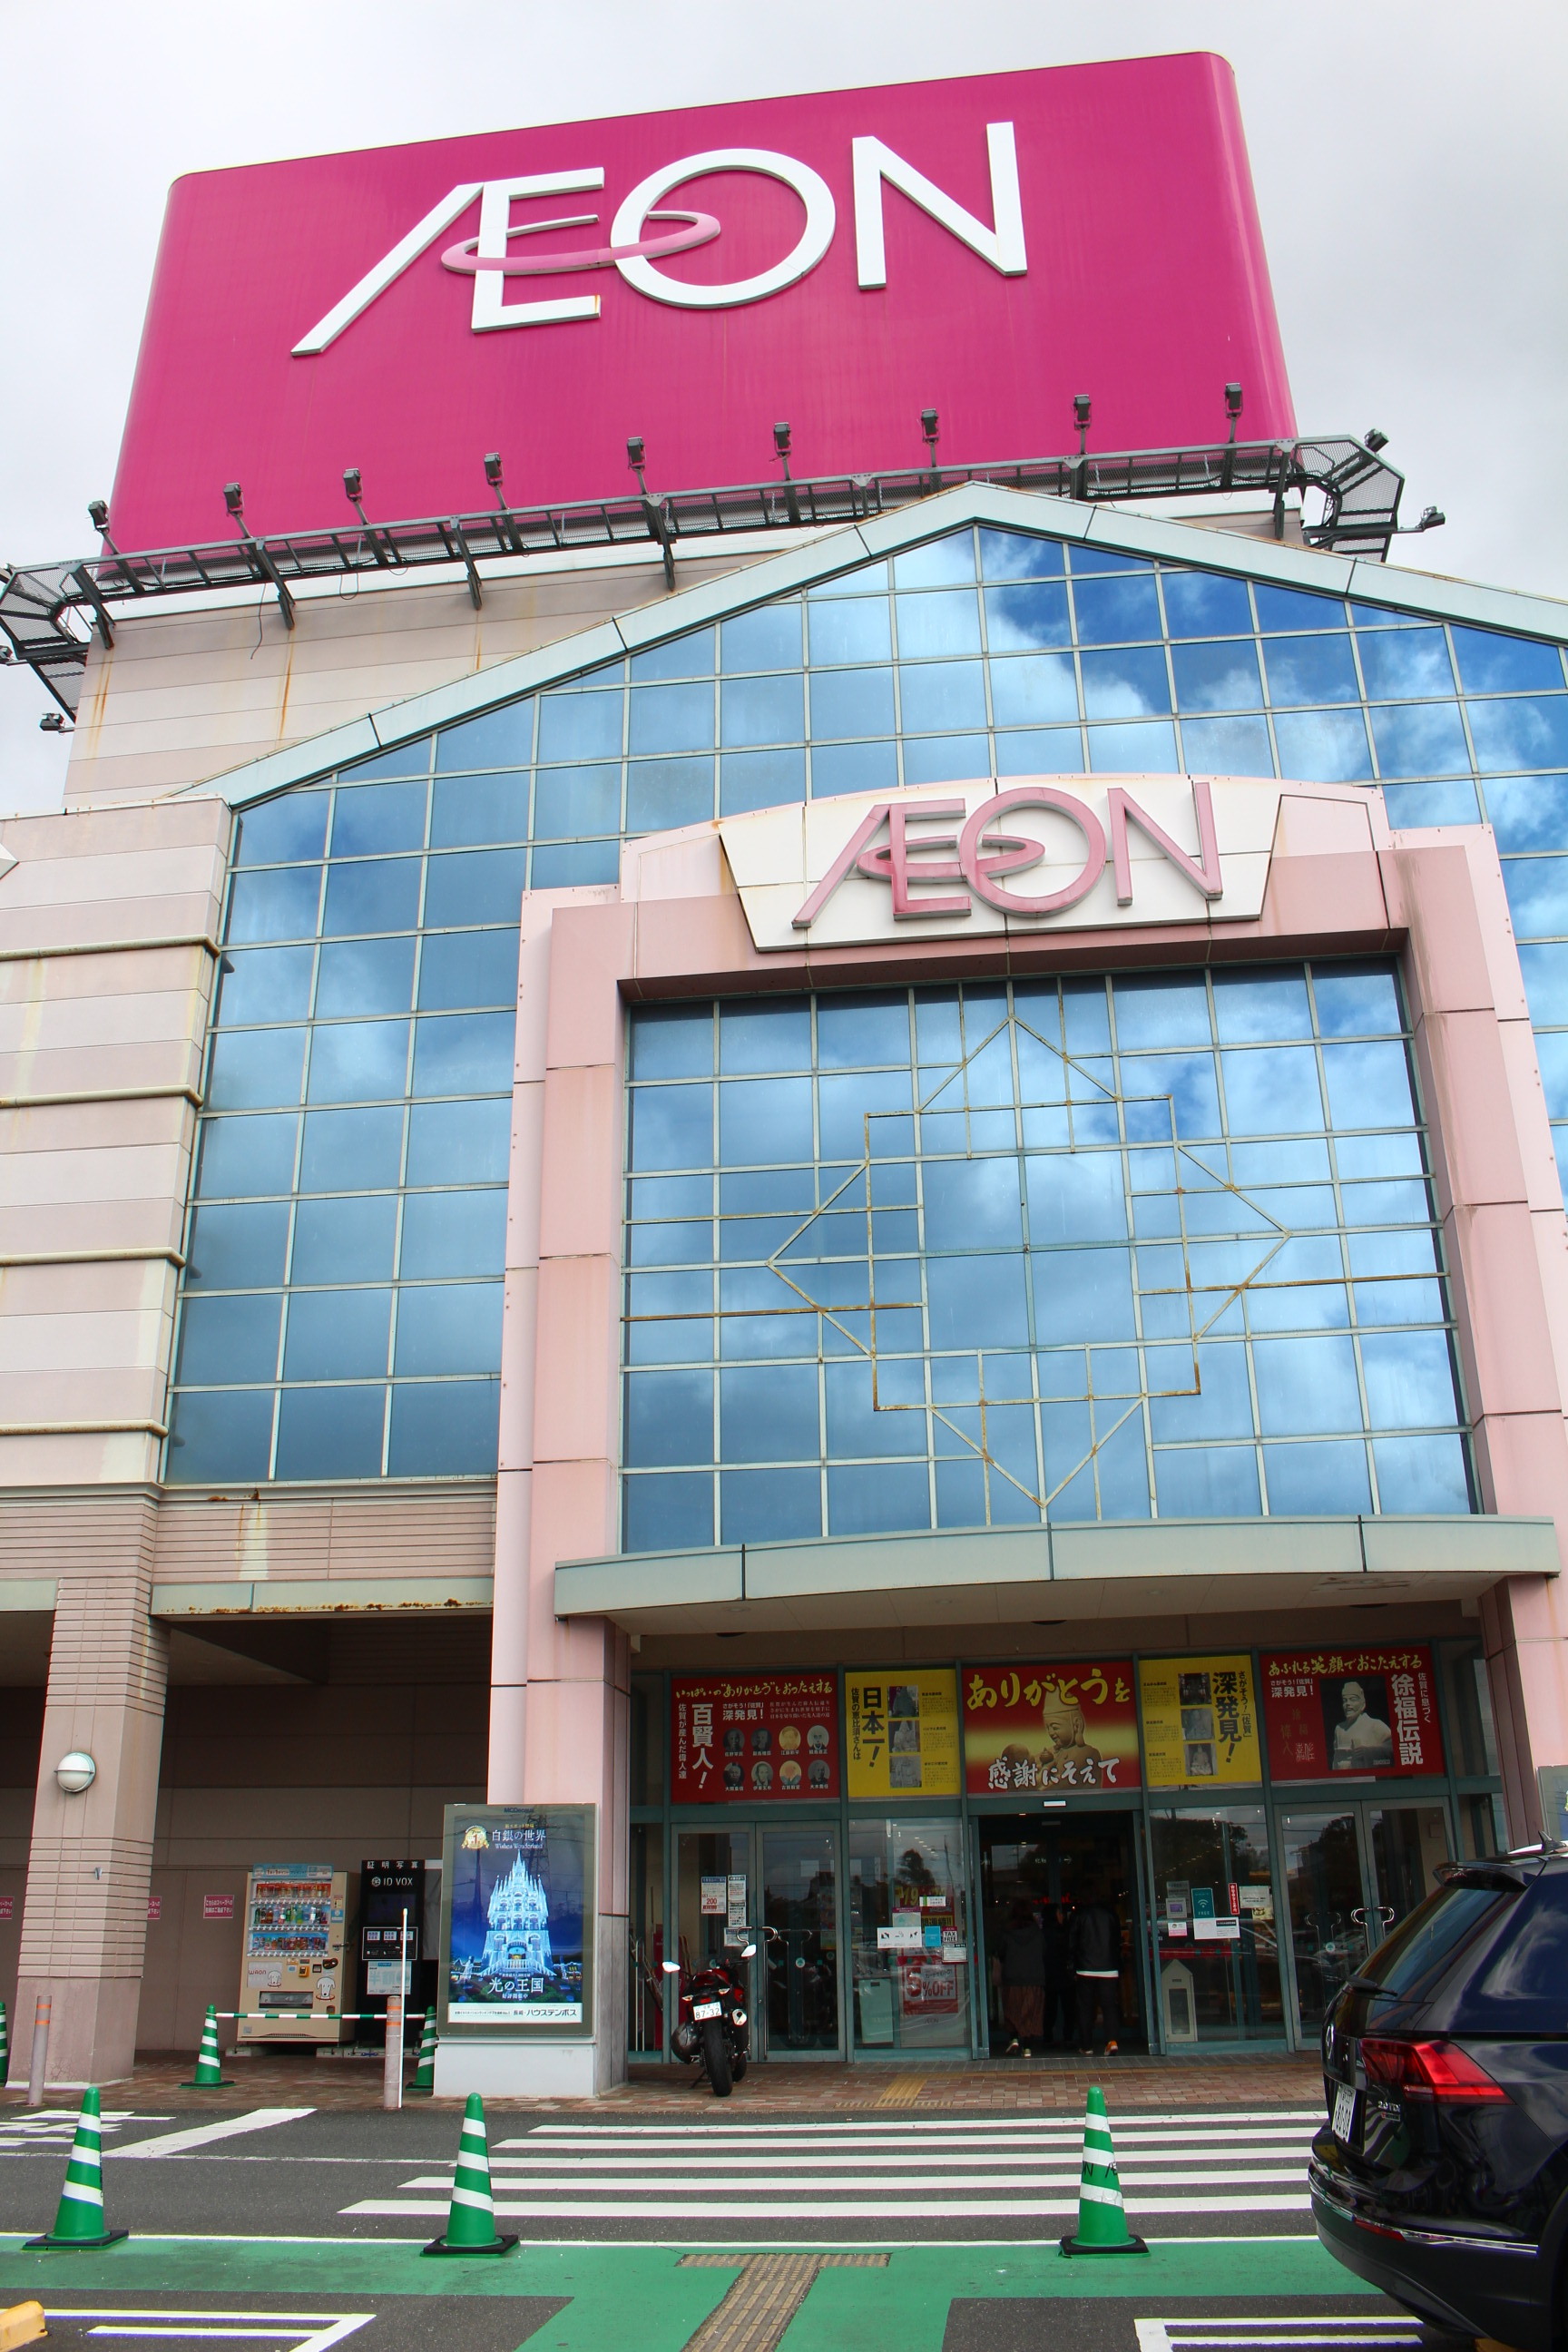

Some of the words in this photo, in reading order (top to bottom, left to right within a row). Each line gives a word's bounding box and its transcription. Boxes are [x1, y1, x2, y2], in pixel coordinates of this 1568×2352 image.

[1269, 1653, 1422, 1676] あふれる笑顔でおこたえする
[1391, 1672, 1424, 1766] 徐福伝説
[988, 1756, 1120, 1789] 感謝にそえて
[492, 1829, 546, 1842] 白銀の世界
[383, 1877, 393, 1886] ID
[395, 1877, 413, 1886] VOX
[487, 1977, 544, 1994] 光の王国
